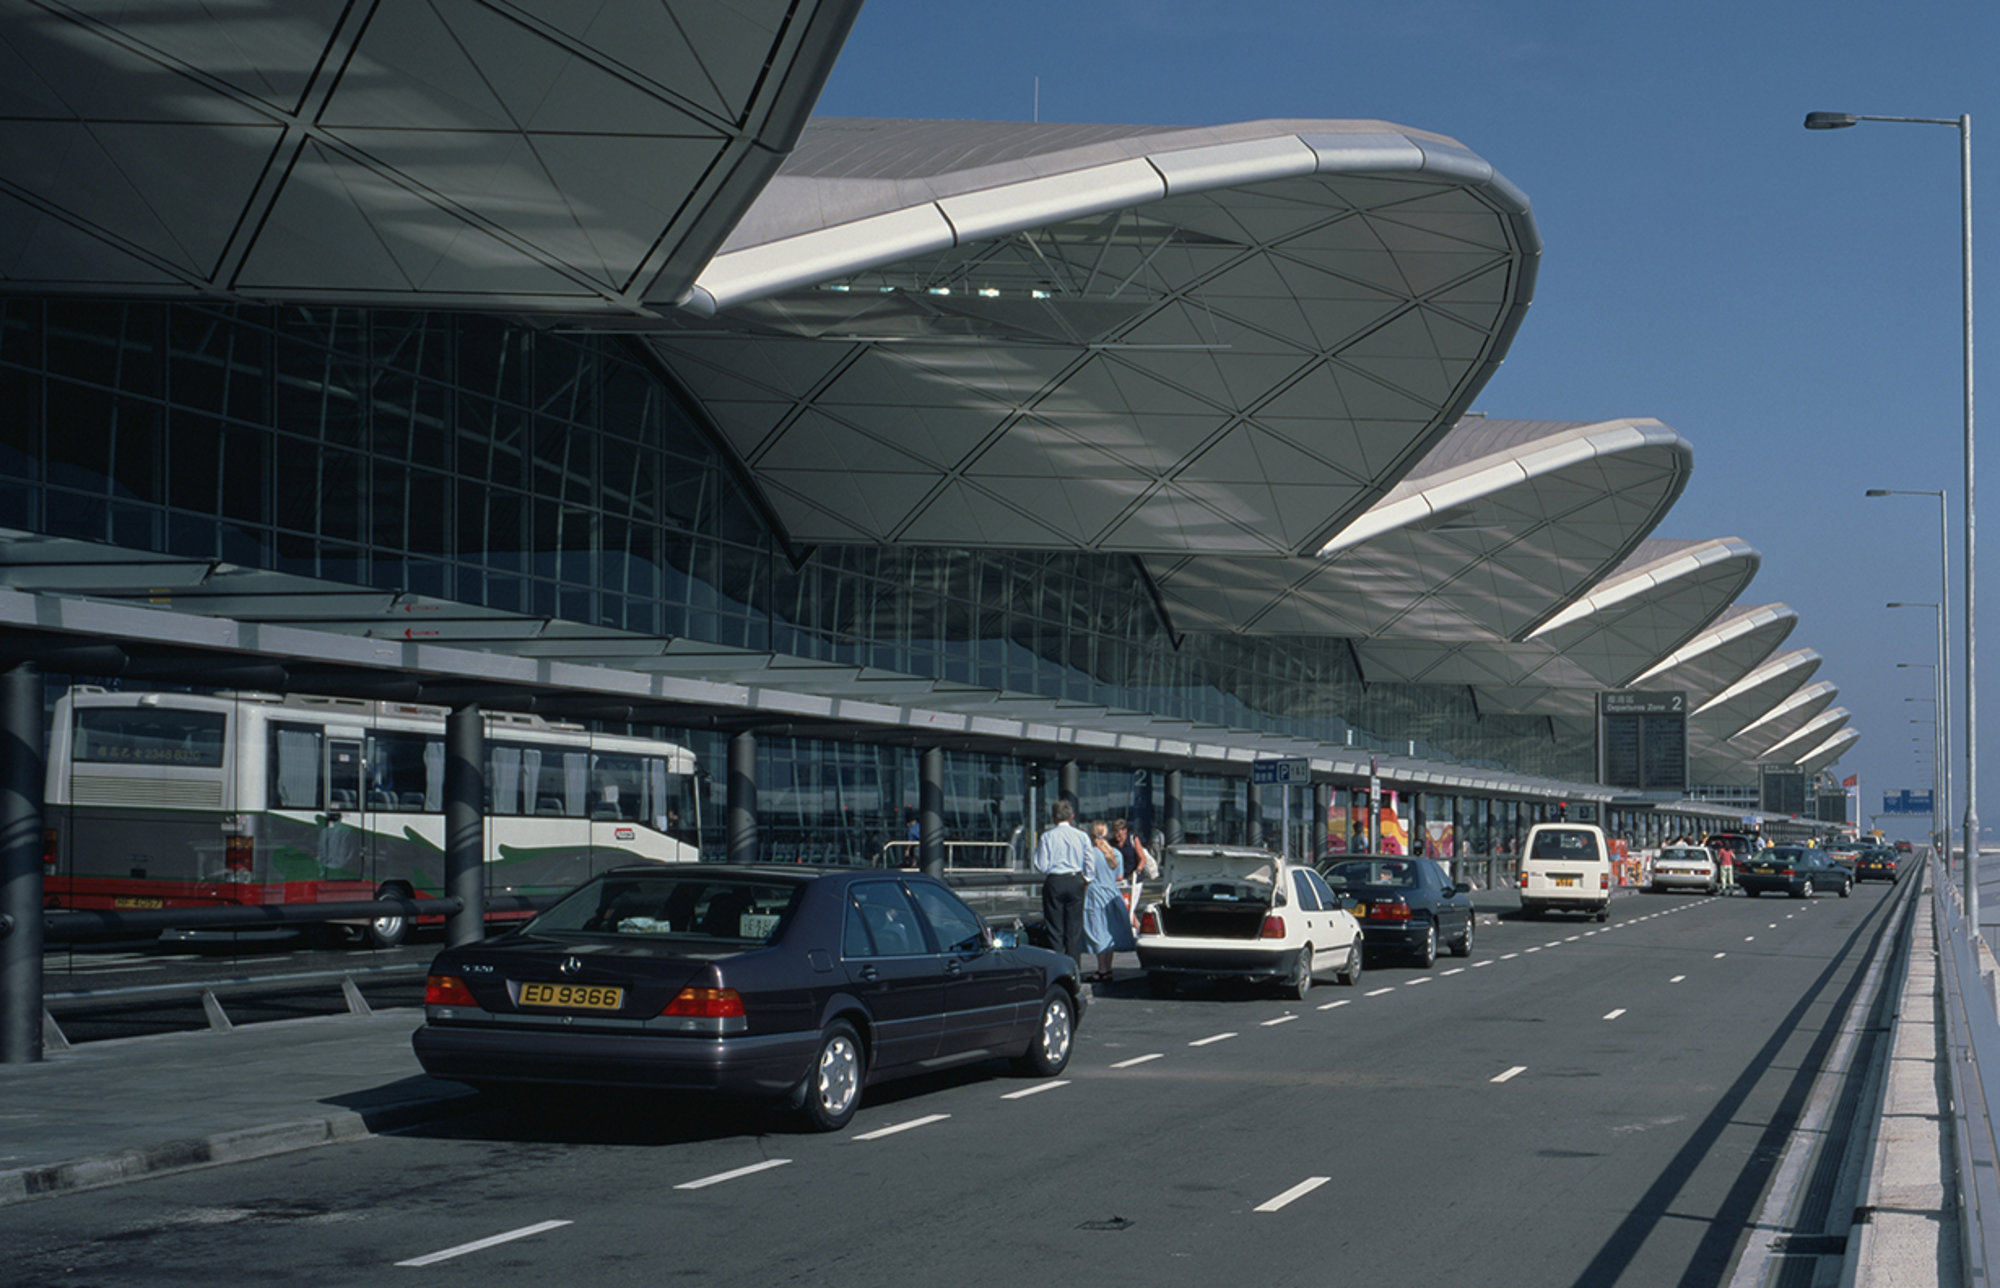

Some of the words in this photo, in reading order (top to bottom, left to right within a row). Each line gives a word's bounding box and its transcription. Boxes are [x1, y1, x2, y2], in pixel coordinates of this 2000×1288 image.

[1672, 695, 1682, 711] 2
[1134, 768, 1147, 786] 2
[525, 984, 554, 1003] ED
[558, 986, 617, 1006] 9366
